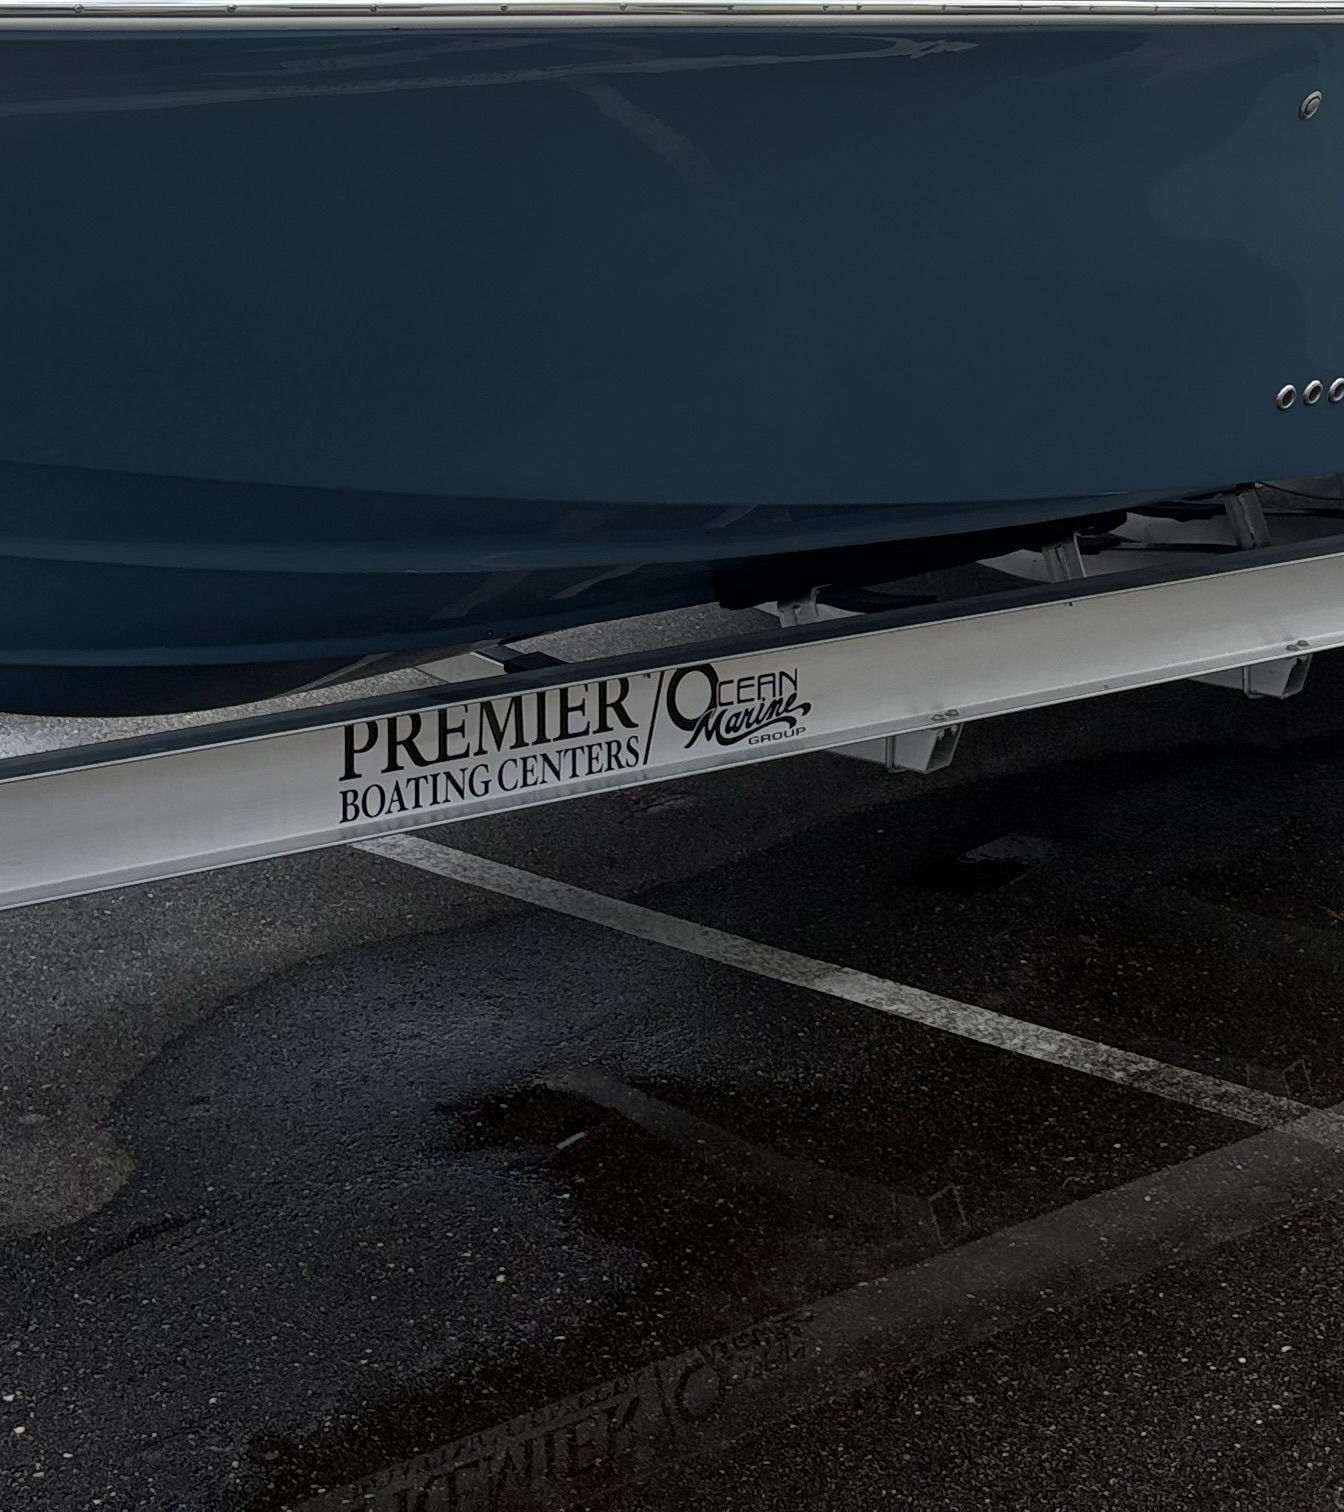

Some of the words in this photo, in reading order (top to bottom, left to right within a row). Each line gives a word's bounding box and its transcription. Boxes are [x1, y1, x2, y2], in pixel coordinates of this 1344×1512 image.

[338, 675, 639, 781] PREMIER
[666, 663, 798, 732] OCEAN
[684, 692, 812, 746] Marine
[748, 727, 806, 745] GROUP
[339, 764, 492, 824] BOATING
[498, 734, 640, 790] CENTERS
